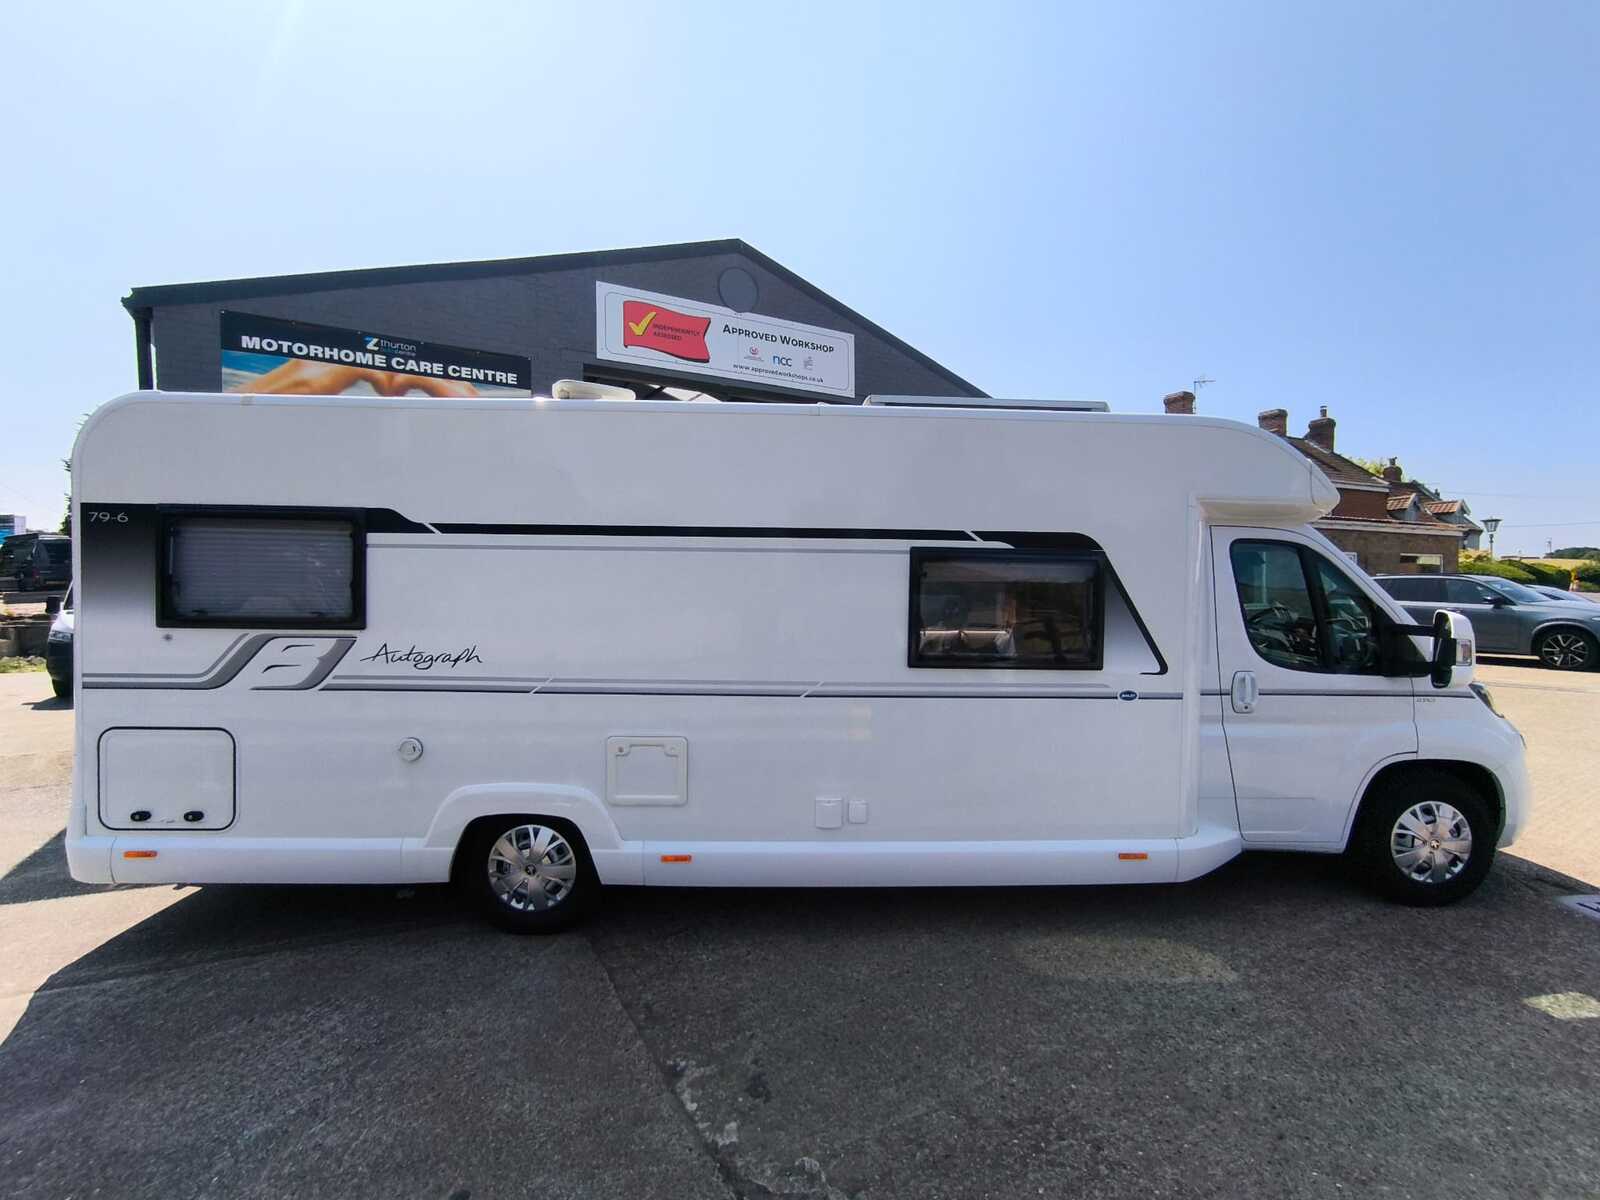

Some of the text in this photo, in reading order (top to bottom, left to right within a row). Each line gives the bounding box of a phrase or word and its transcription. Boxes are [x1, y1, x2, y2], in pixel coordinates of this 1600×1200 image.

[241, 335, 387, 368] MOTORHOME
[391, 357, 444, 375] CARE
[447, 365, 518, 385] CENTRE
[88, 511, 129, 523] 79-6
[360, 642, 483, 670] Autograph
